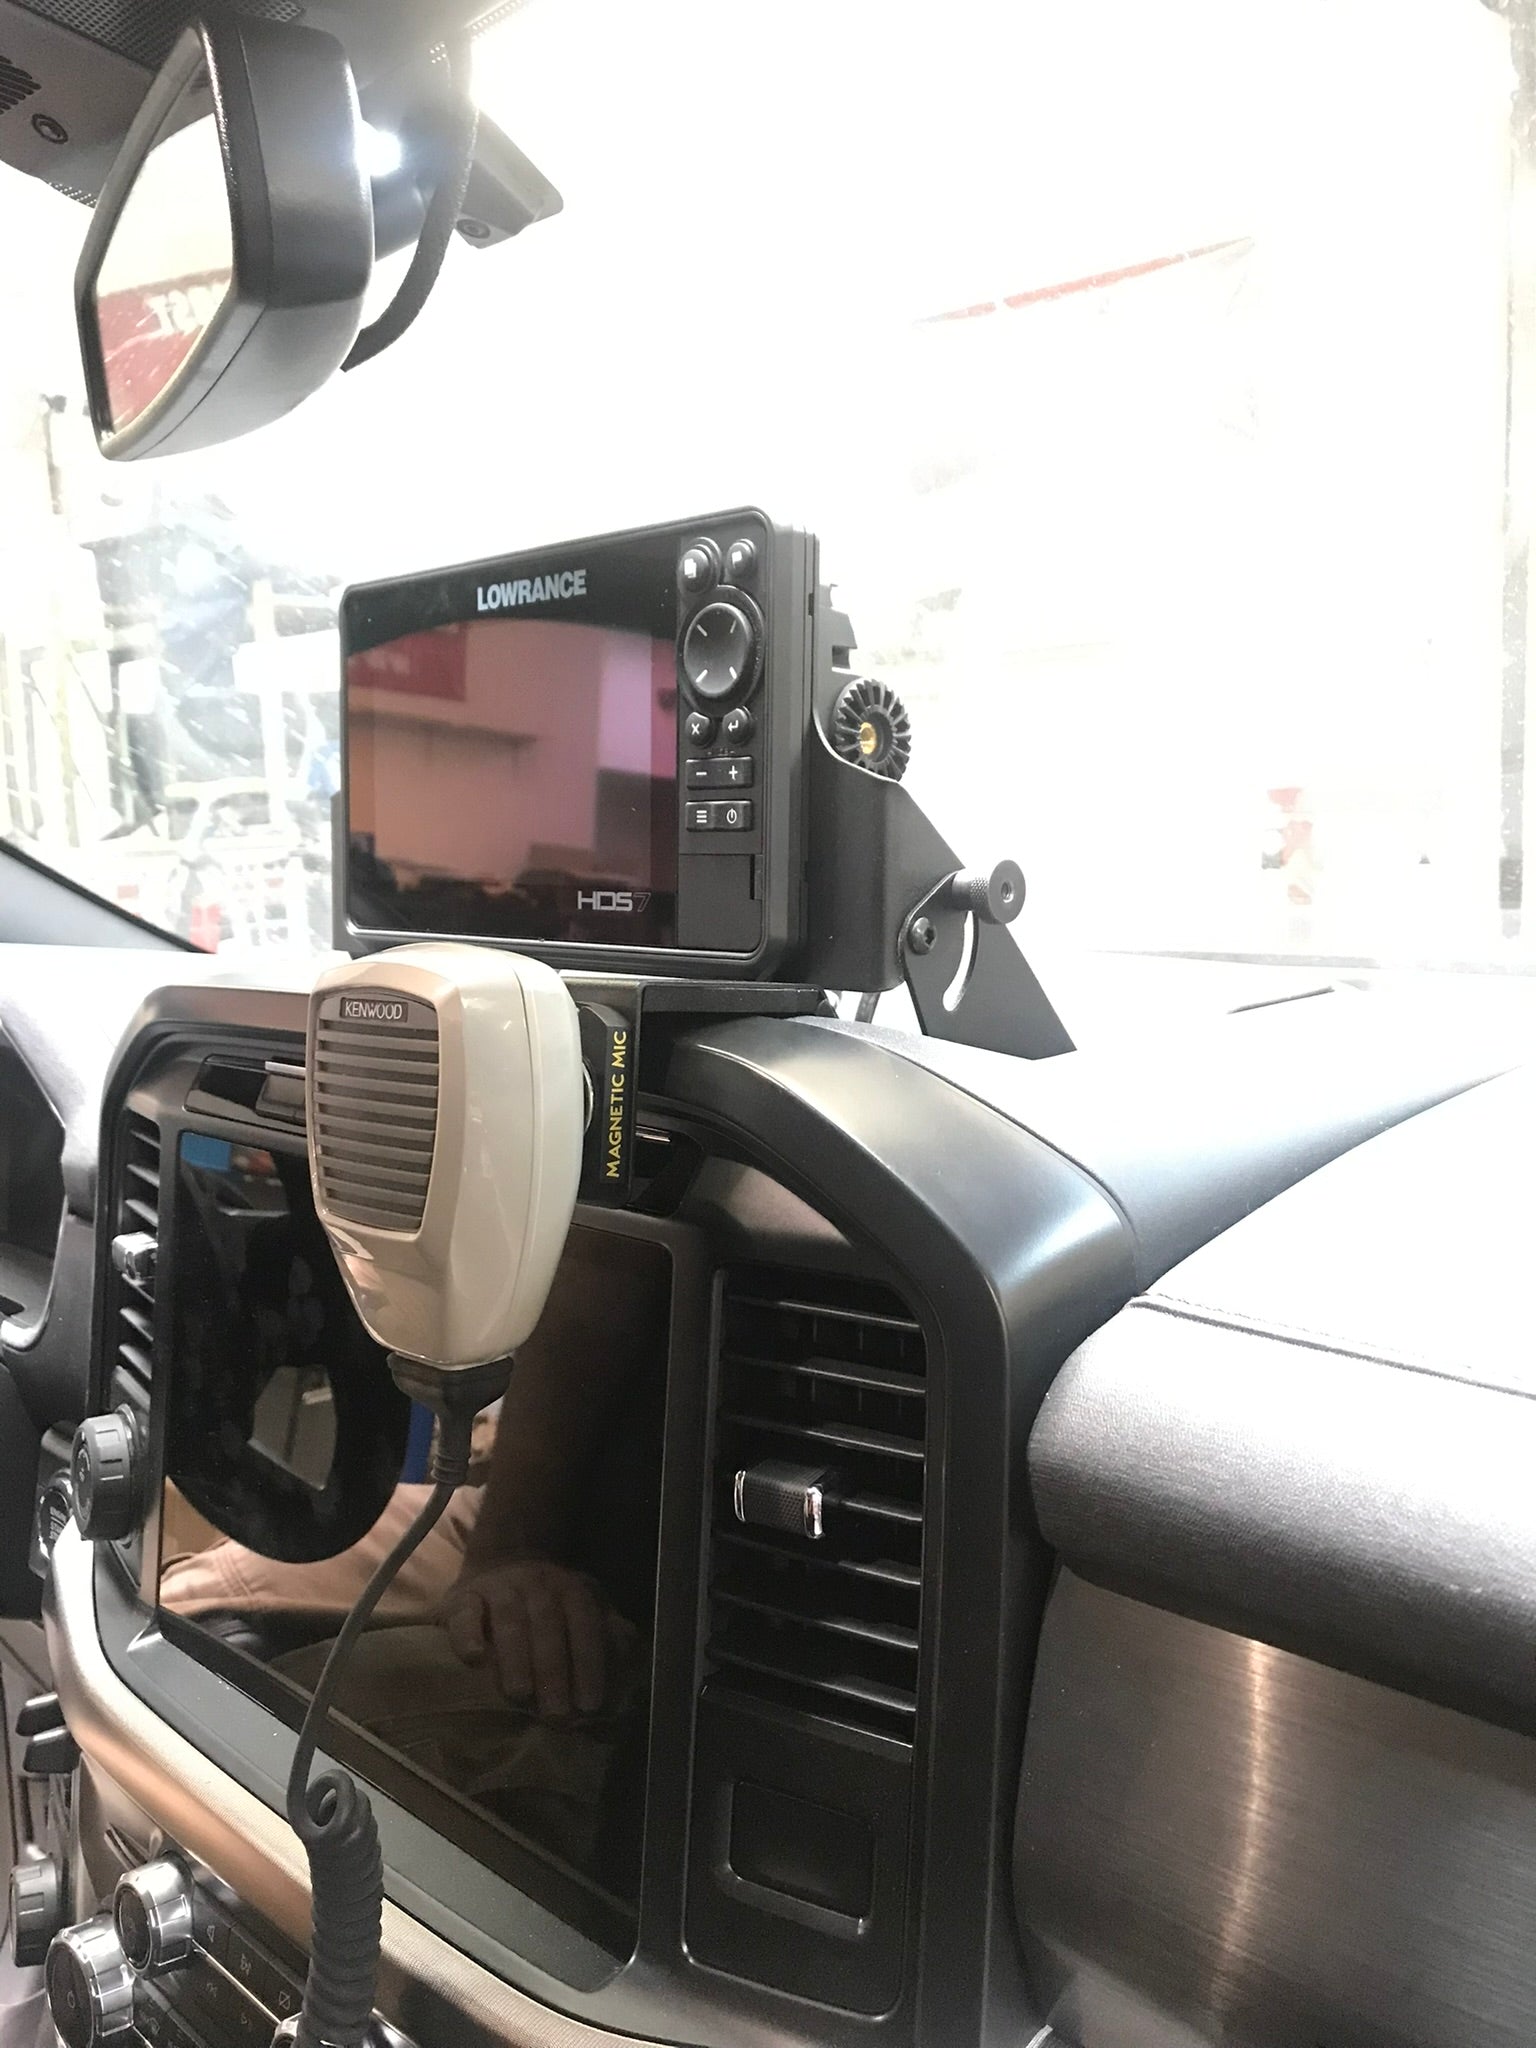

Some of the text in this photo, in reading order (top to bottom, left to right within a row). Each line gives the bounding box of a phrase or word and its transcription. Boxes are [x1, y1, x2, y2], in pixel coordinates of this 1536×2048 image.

[477, 569, 587, 611] LOWRANCE
[345, 1001, 403, 1020] KENWOOD
[606, 1031, 627, 1178] MAGNETIC MIC
